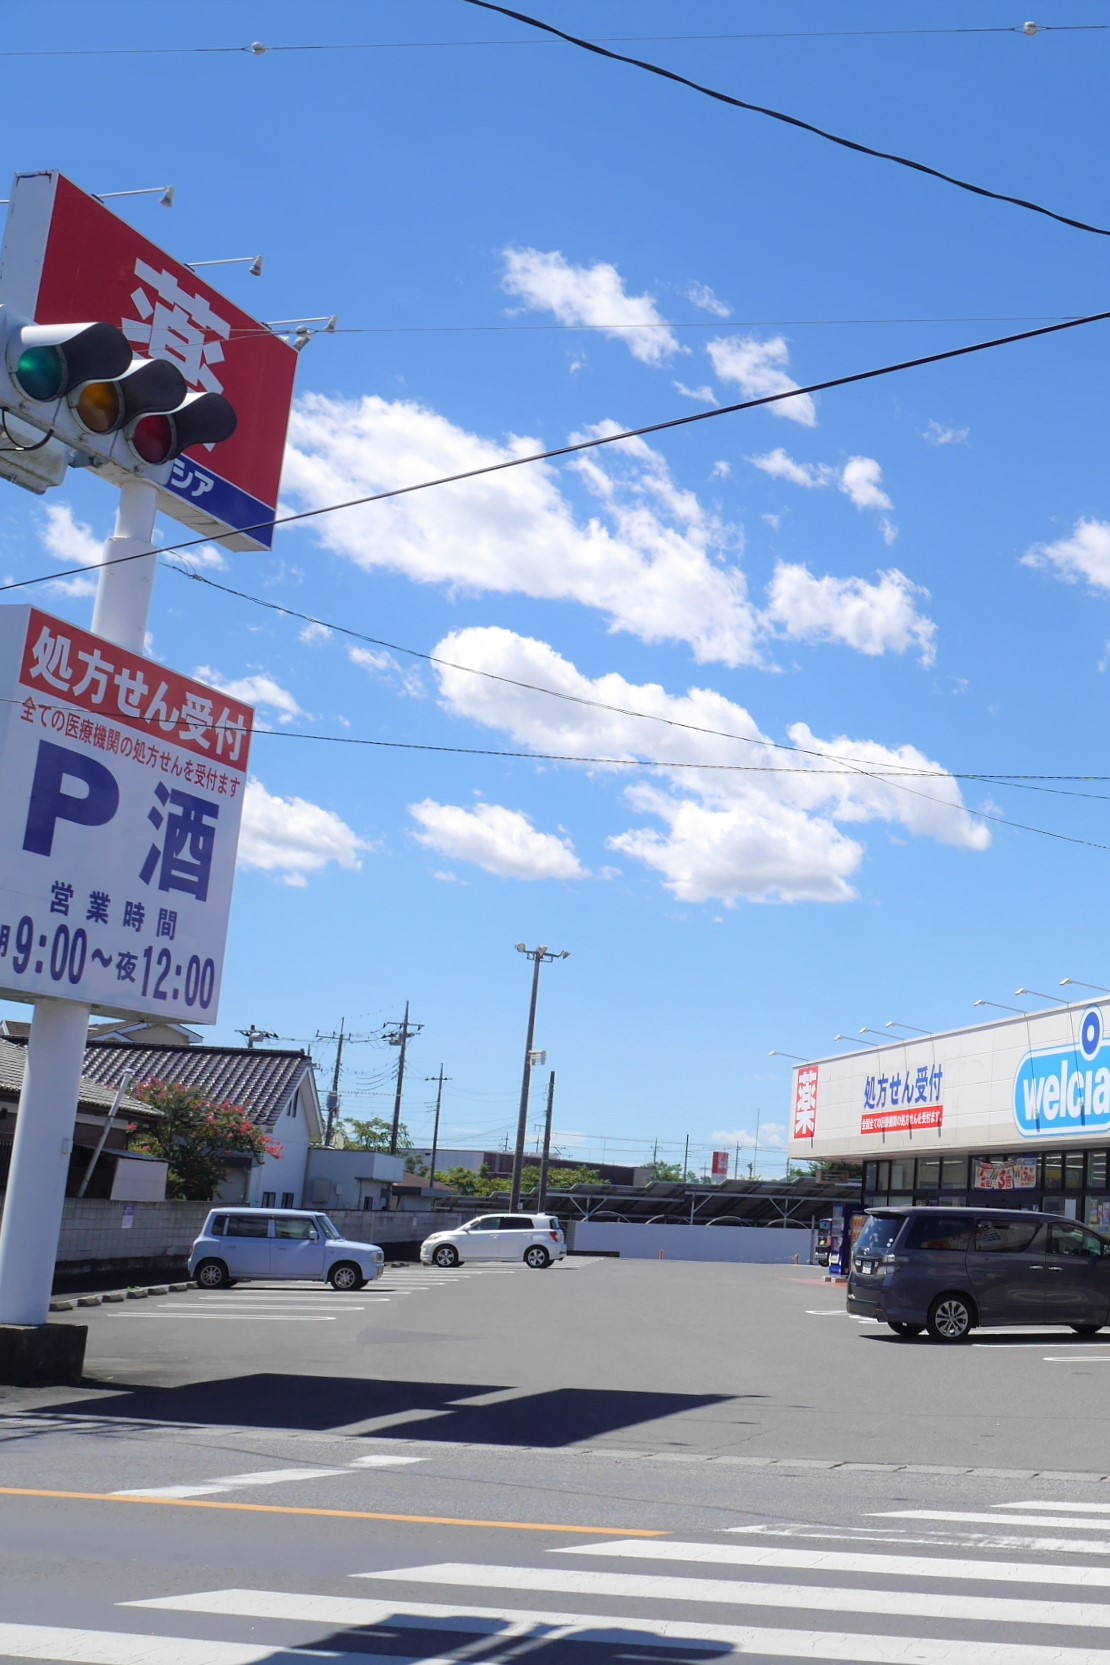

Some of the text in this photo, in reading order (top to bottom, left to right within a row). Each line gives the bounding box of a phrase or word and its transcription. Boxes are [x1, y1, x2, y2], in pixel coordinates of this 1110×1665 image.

[170, 461, 215, 498] シア
[29, 625, 247, 762] 処方せん受付
[20, 696, 241, 799] 全ての医療機関の処方せんを受付ます
[23, 739, 120, 857] P
[139, 781, 220, 903] 酒
[50, 880, 178, 941] 営業時間
[794, 1068, 818, 1138] 薬
[864, 1064, 943, 1110] 処方せん受付
